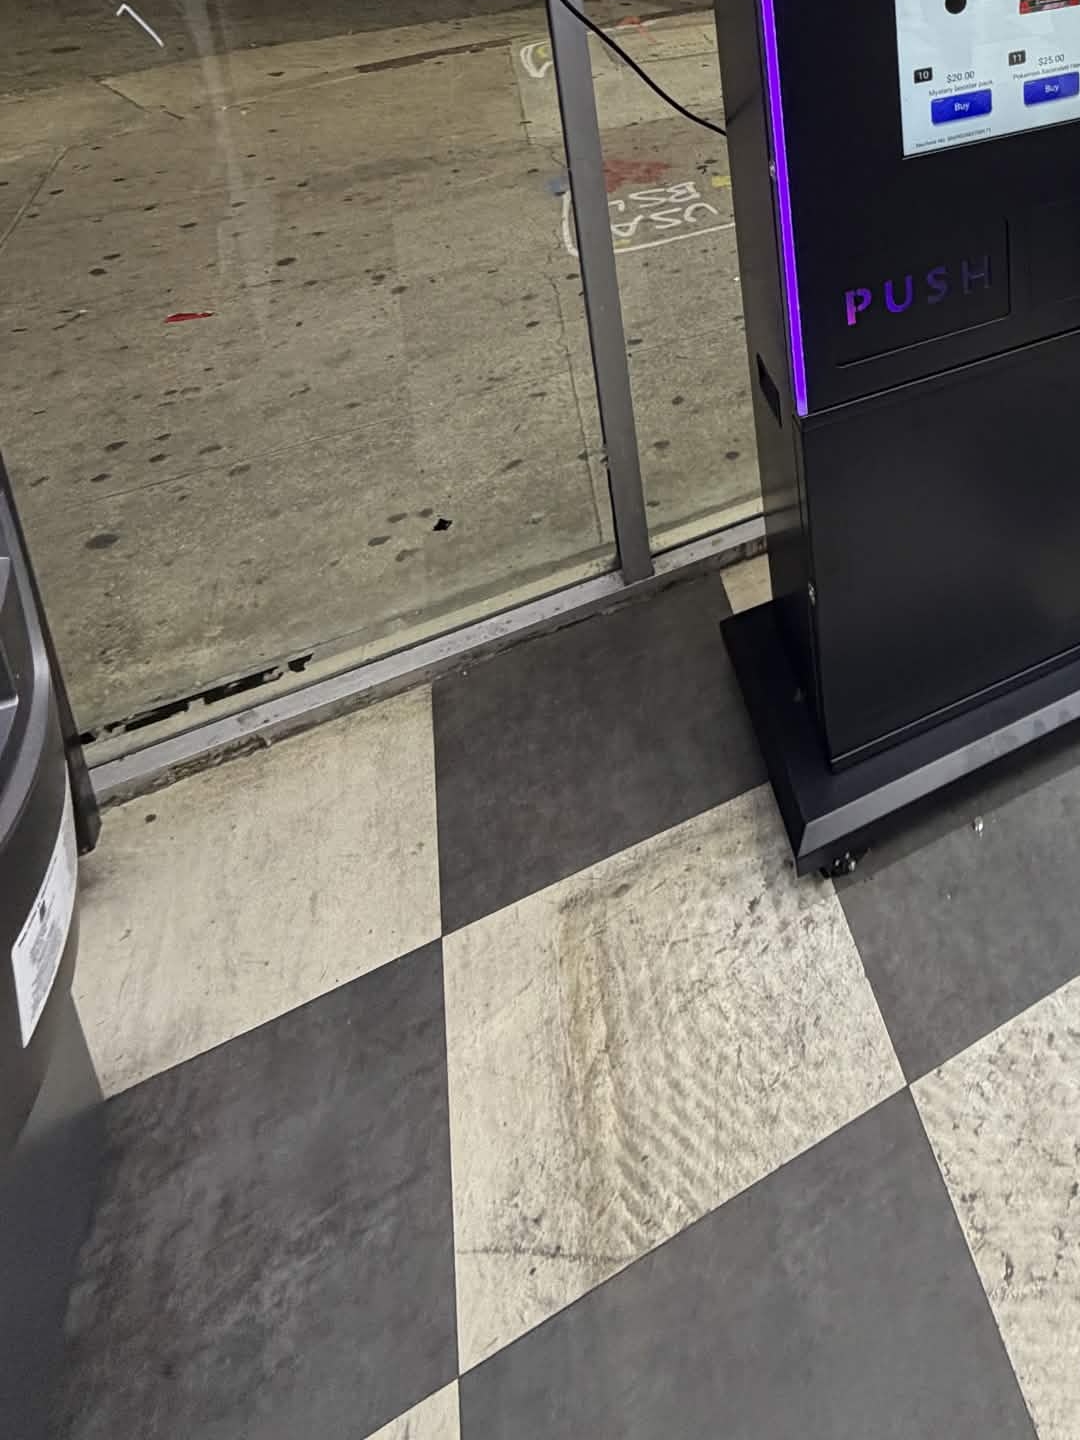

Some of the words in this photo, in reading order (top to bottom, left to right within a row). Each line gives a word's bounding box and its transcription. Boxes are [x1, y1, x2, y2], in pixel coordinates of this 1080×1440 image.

[1012, 54, 1023, 64] 11
[1038, 54, 1065, 67] $25.00
[918, 70, 929, 80] 10
[946, 71, 975, 84] $20.00
[1044, 84, 1059, 94] Buy
[954, 103, 970, 113] Buy
[844, 255, 992, 327] PUSH
